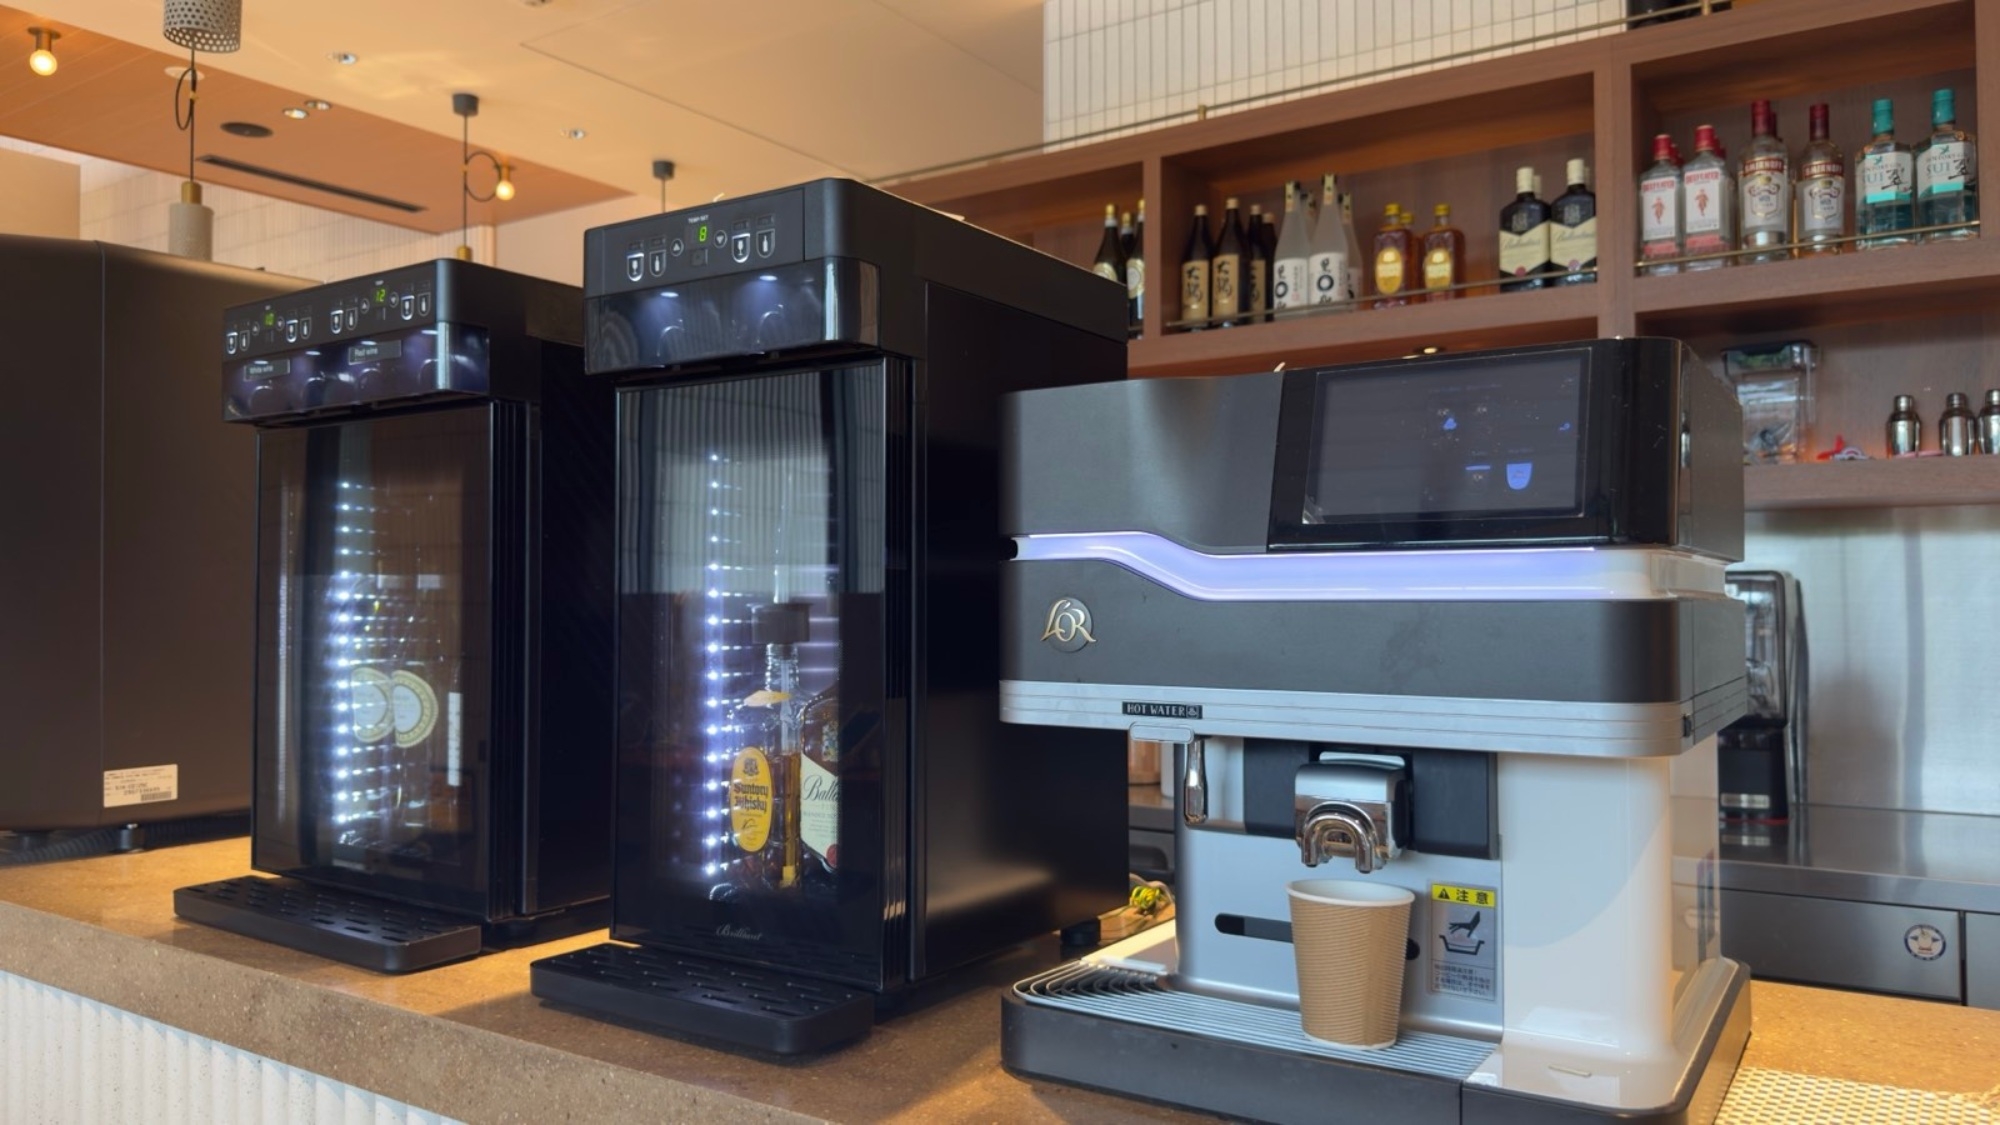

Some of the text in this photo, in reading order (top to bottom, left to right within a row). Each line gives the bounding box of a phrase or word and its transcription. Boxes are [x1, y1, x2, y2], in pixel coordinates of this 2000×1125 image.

[699, 226, 707, 242] 8
[1127, 703, 1185, 716] HOT WATER
[1456, 889, 1489, 905] 注意
